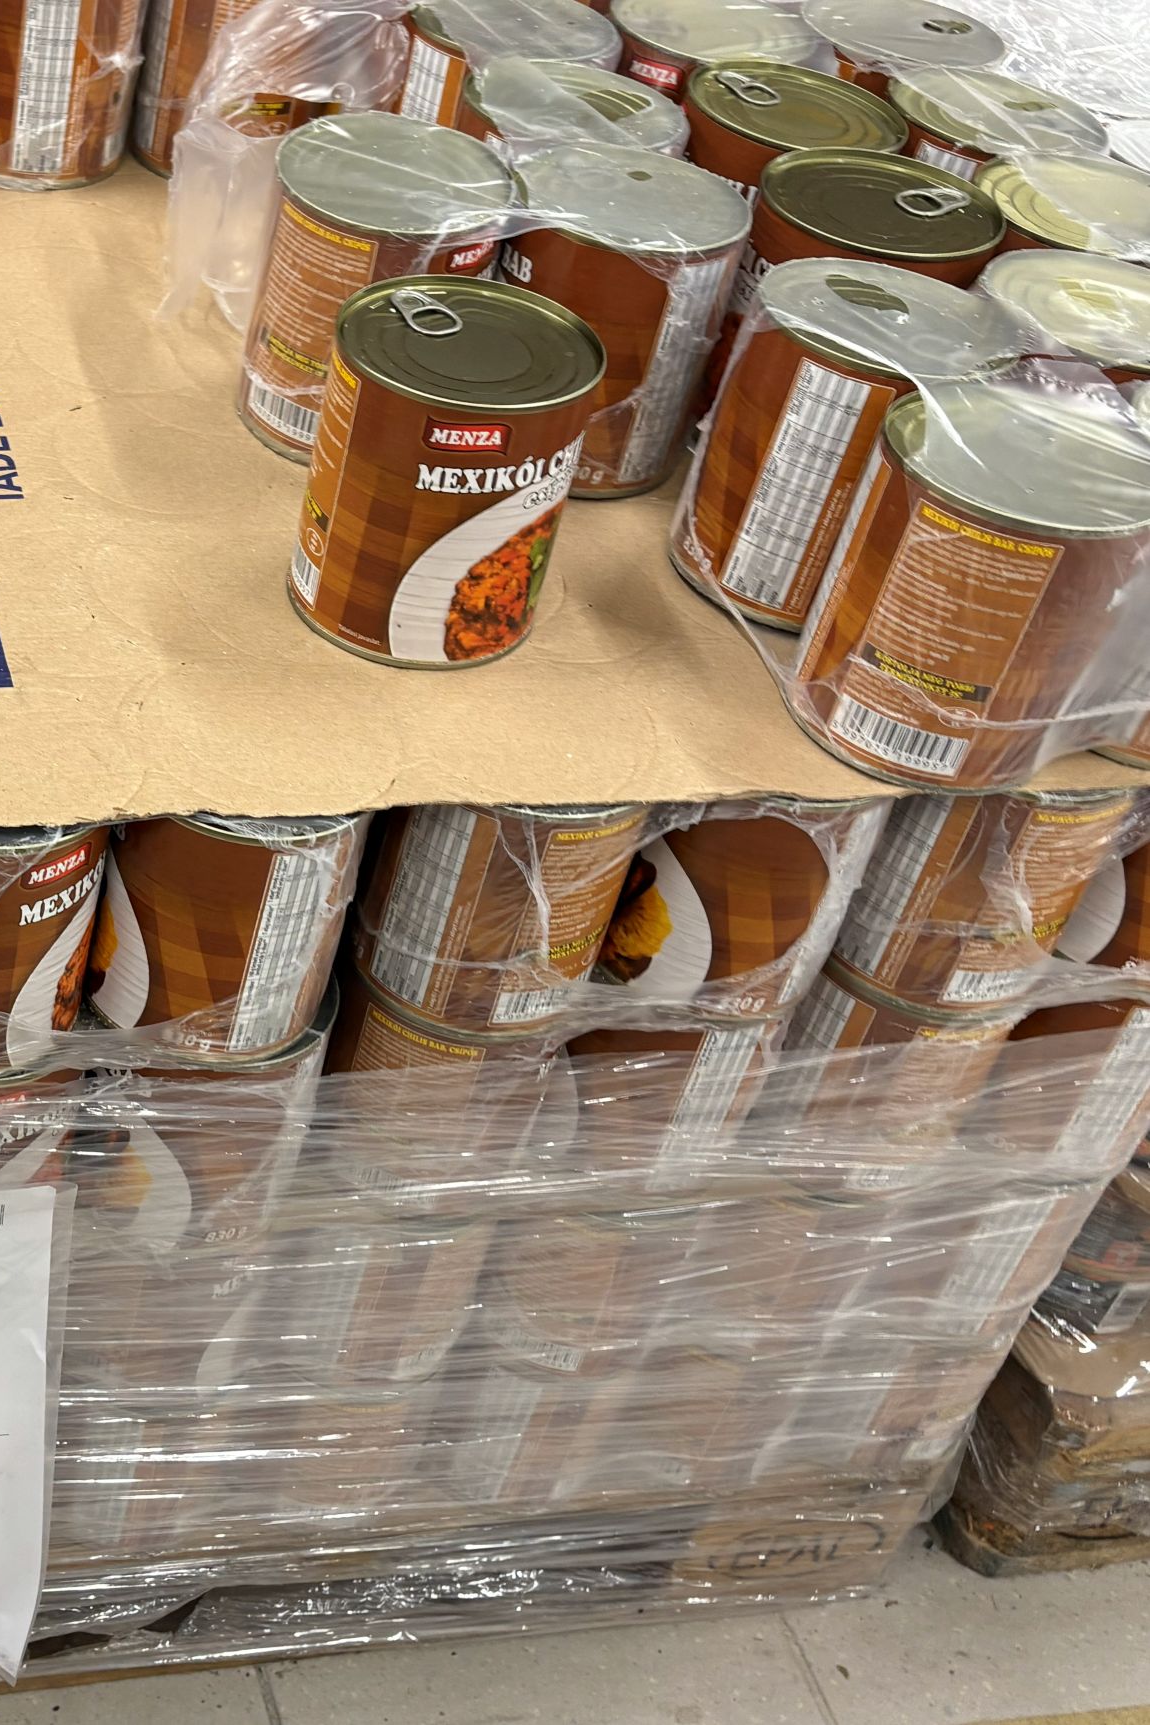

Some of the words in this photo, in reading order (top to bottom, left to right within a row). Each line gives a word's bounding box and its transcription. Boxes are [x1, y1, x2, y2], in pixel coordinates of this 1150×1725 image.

[429, 428, 502, 446] MENZA
[415, 456, 546, 494] MEXIKÓI
[28, 849, 86, 885] MENZA
